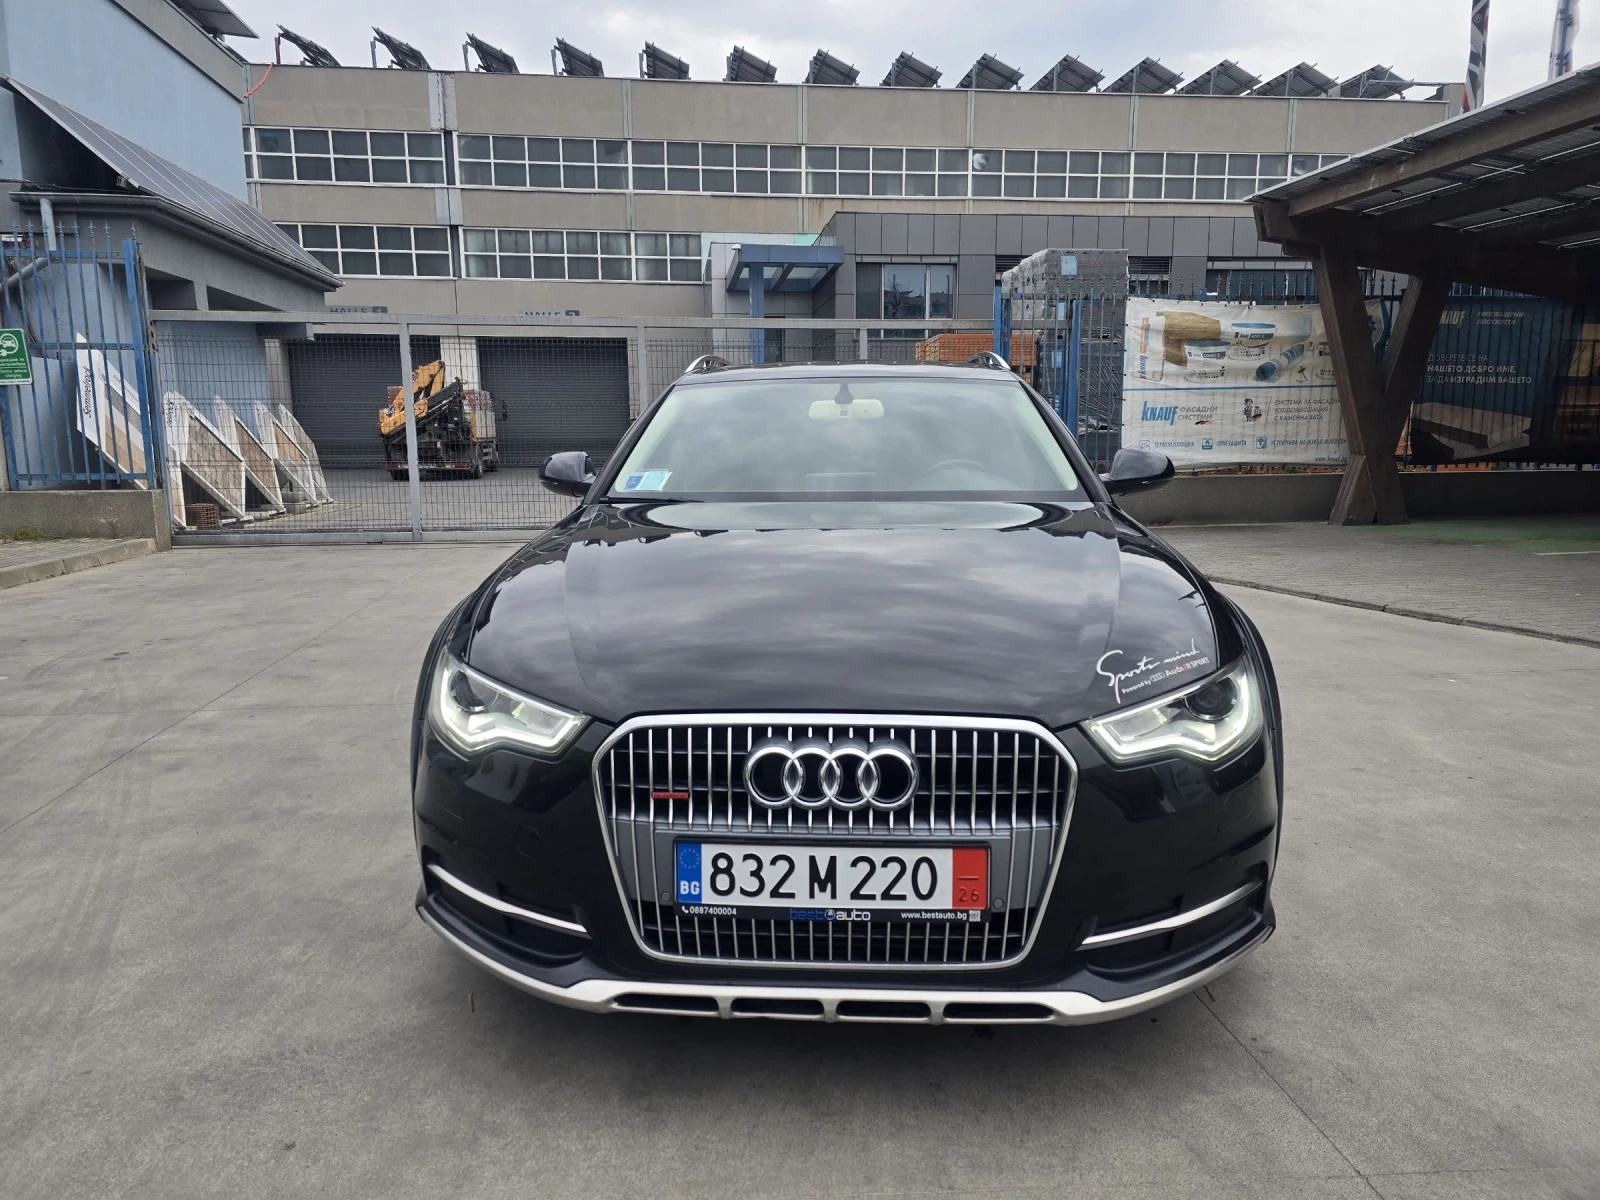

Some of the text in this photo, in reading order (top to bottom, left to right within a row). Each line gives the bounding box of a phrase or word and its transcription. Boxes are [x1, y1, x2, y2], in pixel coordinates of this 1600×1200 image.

[1439, 310, 1467, 329] NAUF
[1428, 354, 1465, 362] ДОВЕРЕТЕ
[1427, 365, 1517, 374] НАШЕТО ДОБРО ИМЕ,
[1437, 375, 1449, 384] ДА
[1450, 376, 1496, 385] ИЗГРАДИМ
[1498, 376, 1532, 384] ВАШЕТО
[82, 365, 93, 418] Semmelrock
[1177, 413, 1213, 421] СИСТЕМИ
[1163, 638, 1200, 664] mind
[1121, 681, 1145, 694] Powered
[1165, 666, 1185, 677] Audi
[709, 852, 938, 901] 832 M 220
[680, 880, 700, 895] BG
[959, 886, 980, 902] 26
[689, 906, 737, 915] 0887400004
[901, 911, 967, 920] www.bestauto.bg
